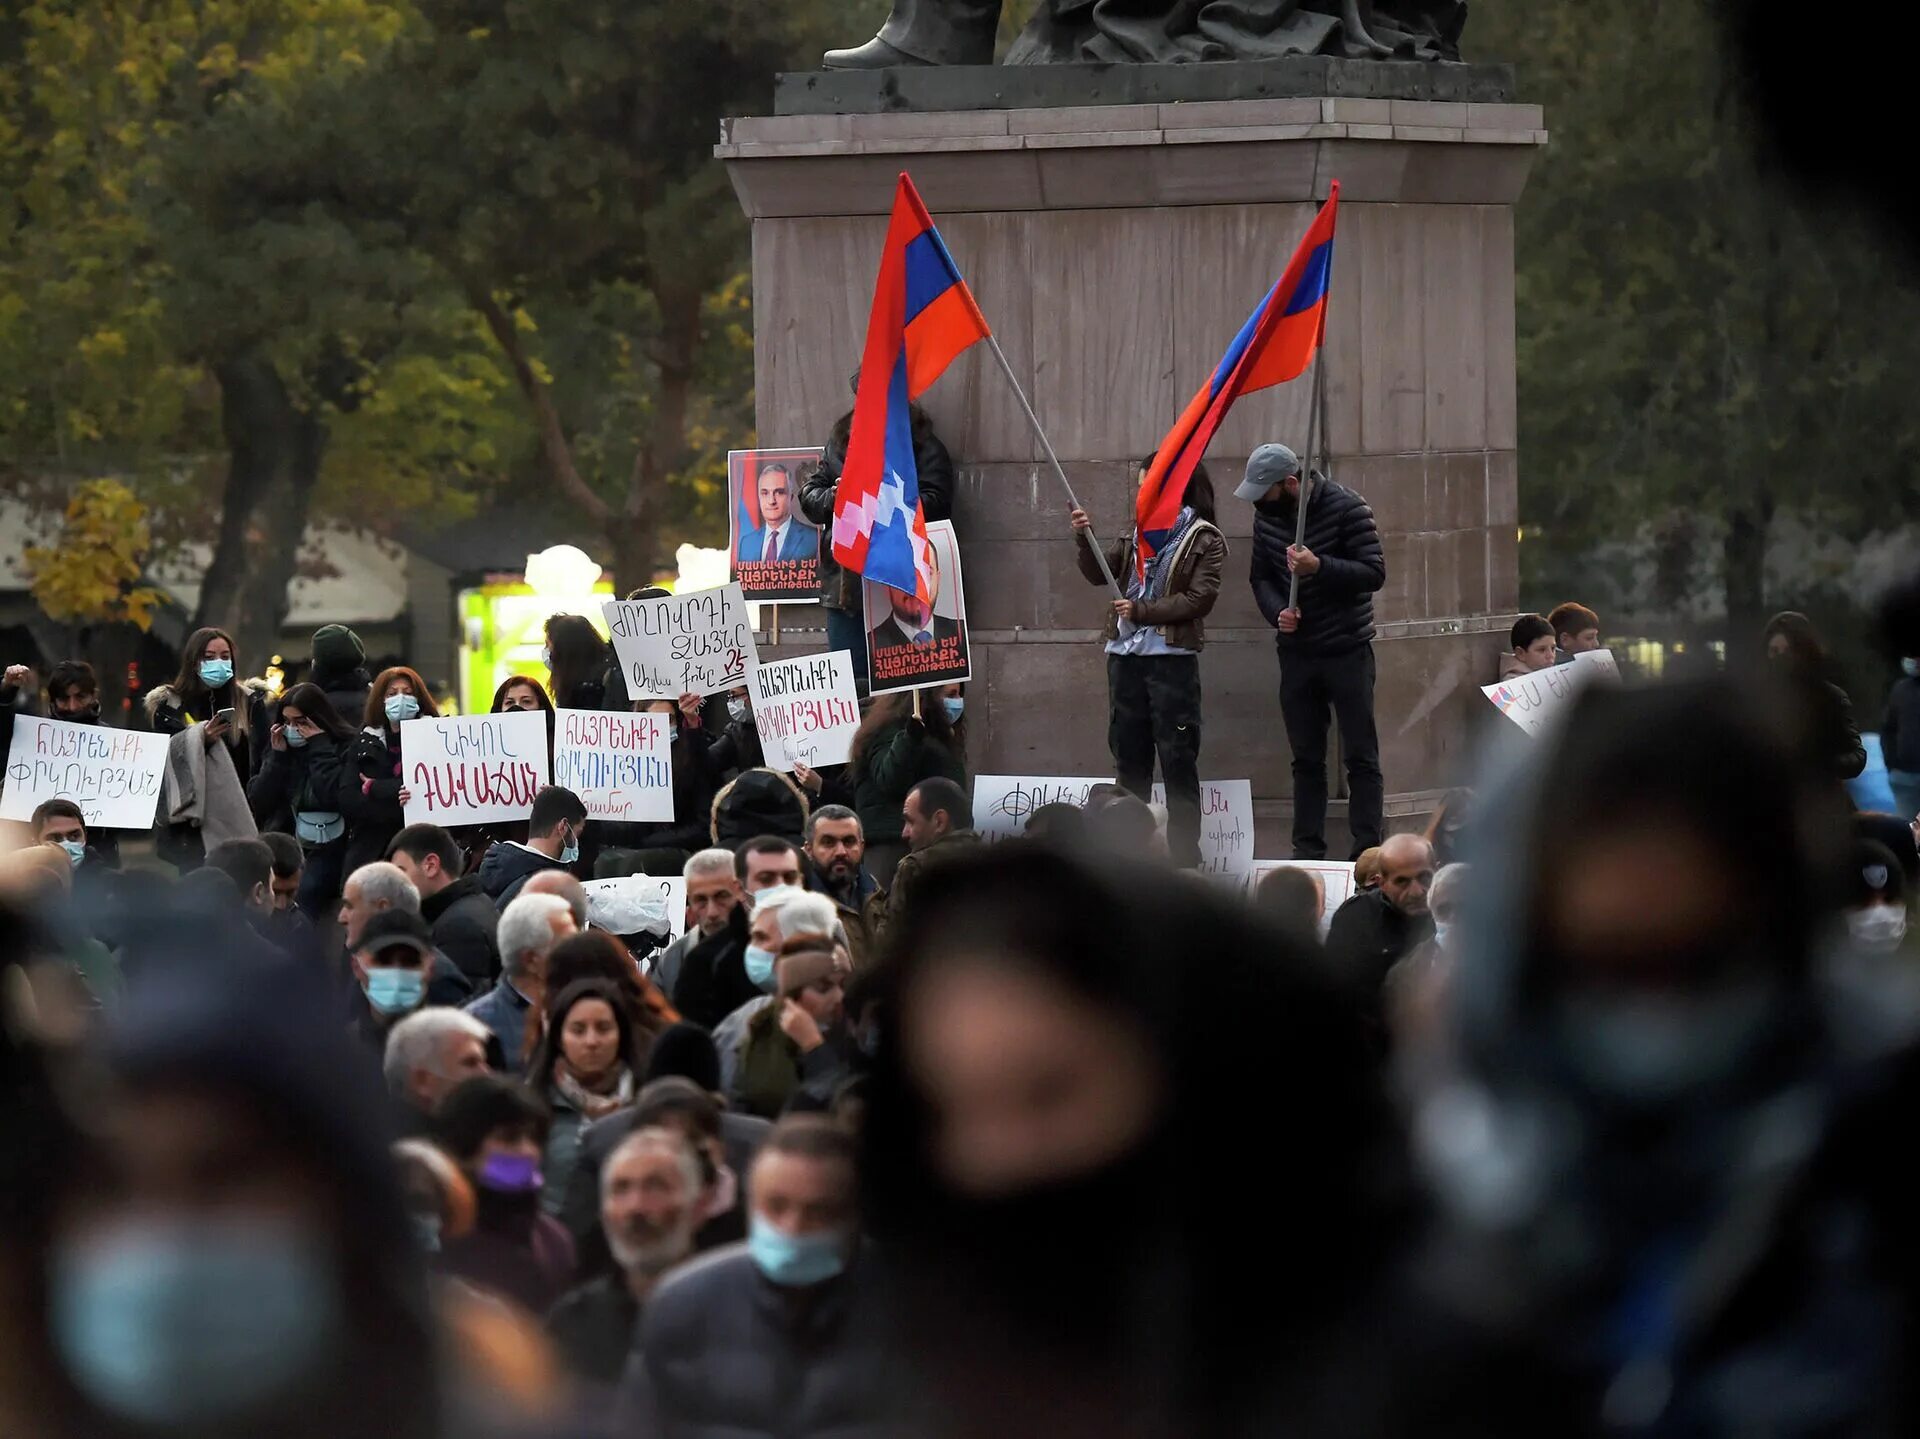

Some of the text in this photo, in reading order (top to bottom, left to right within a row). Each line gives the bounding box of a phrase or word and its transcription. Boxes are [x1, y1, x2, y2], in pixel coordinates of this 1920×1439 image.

[801, 559, 817, 568] ԵՄ
[736, 569, 817, 582] ՀԱՅՐԵՆԻՔԻ
[741, 580, 821, 591] ԱՎԱՃԱՆՈՒԹՅԱՆԸ
[941, 636, 957, 647] ԵՄ
[875, 648, 959, 671] ՀԱՅՐԵՆԻՔԻ
[875, 658, 966, 679] ԴԱՎԱՃԱՆՈՒԹՅԱՆԸ
[437, 721, 518, 758] ՆԻԿՈԼ
